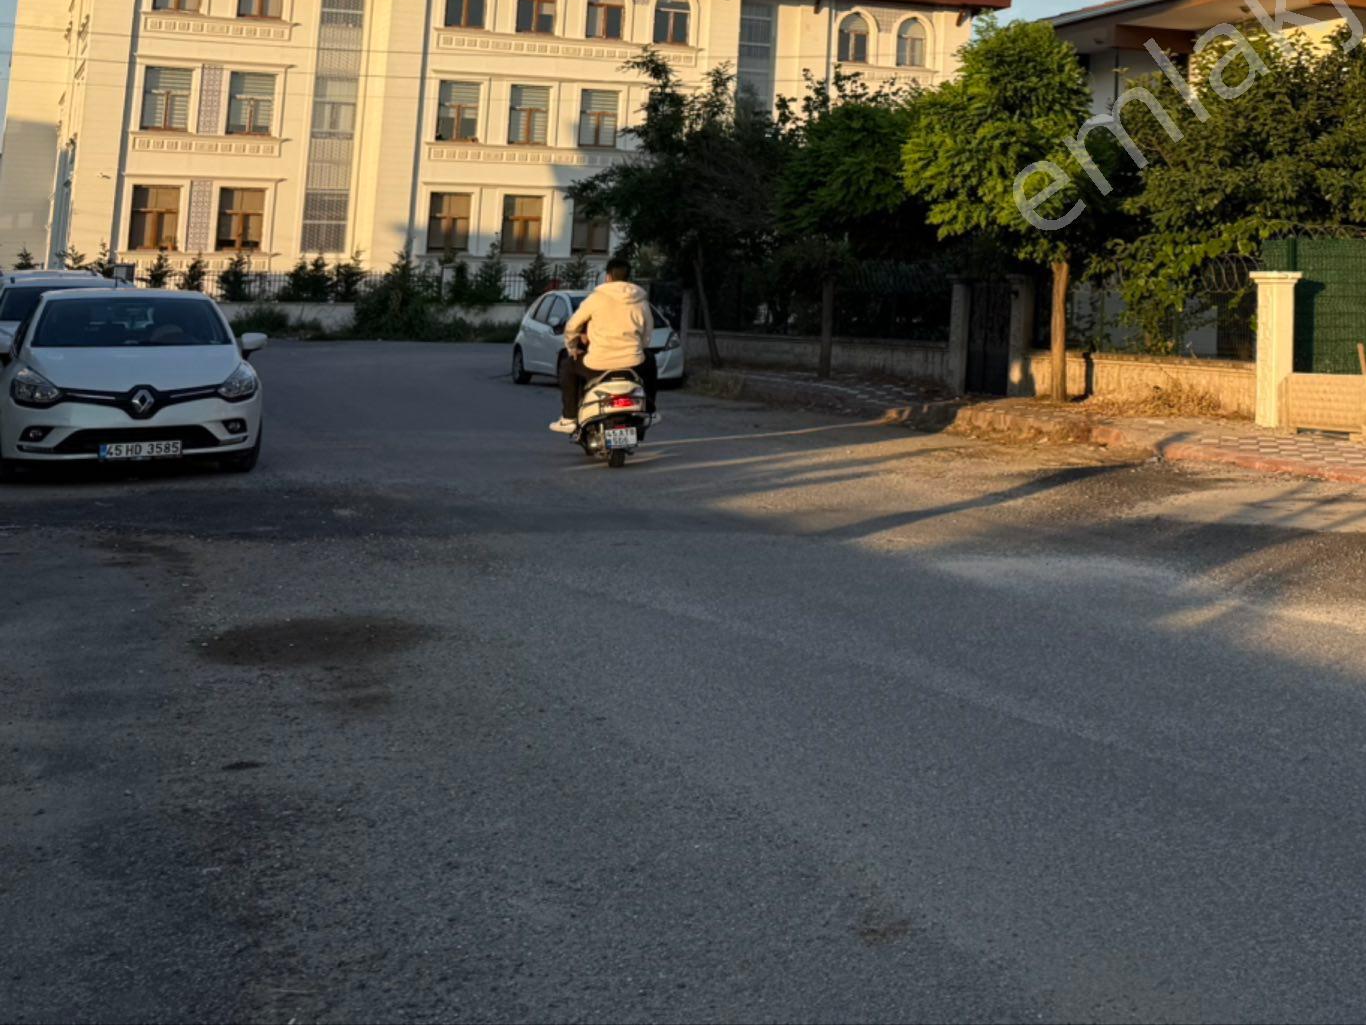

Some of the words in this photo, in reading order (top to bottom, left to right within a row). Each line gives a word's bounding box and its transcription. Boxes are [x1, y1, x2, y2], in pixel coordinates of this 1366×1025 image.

[106, 444, 123, 457] 45
[125, 444, 142, 456] HD
[147, 441, 179, 455] 3585
